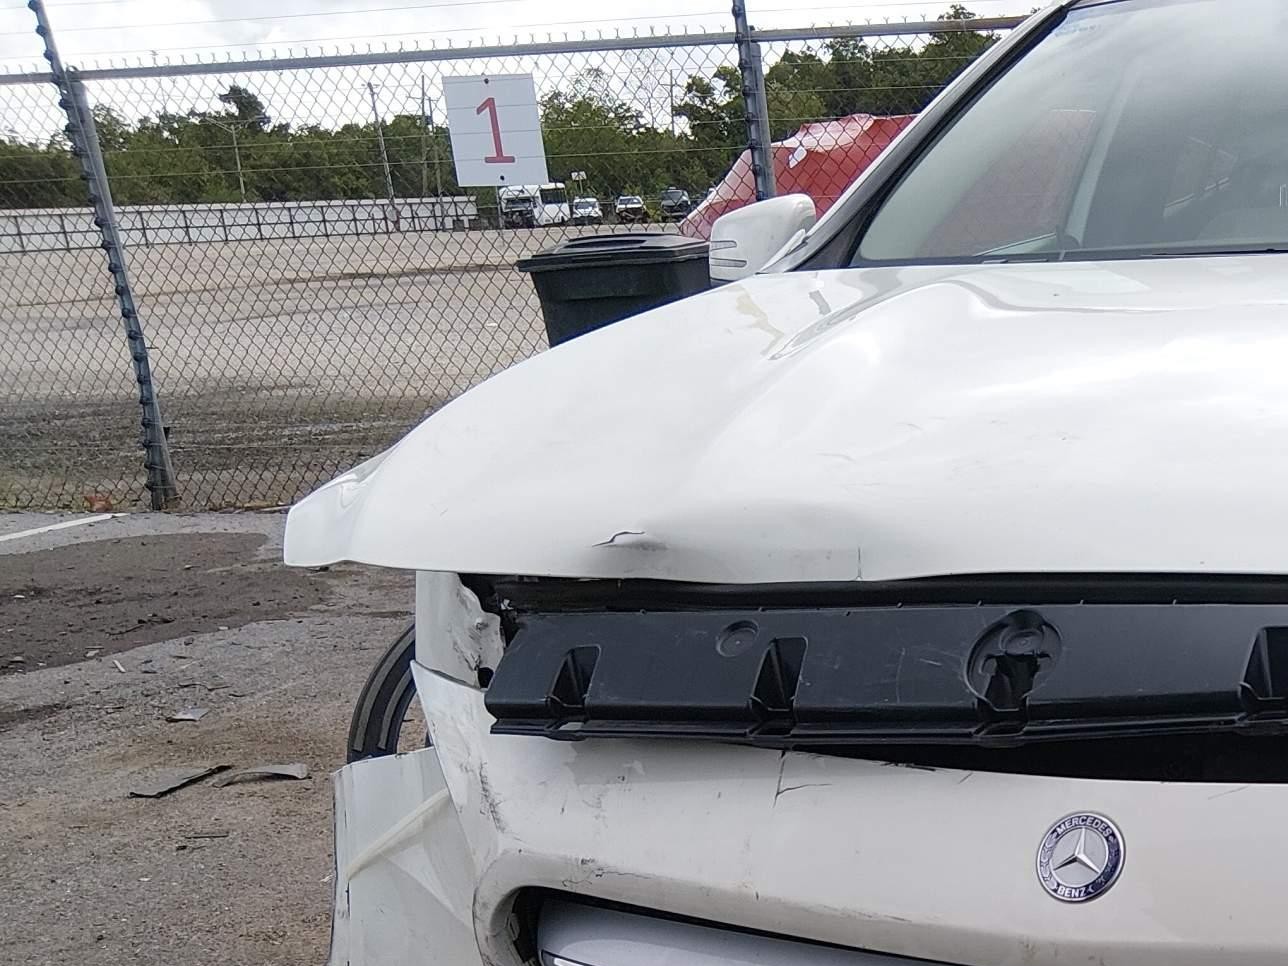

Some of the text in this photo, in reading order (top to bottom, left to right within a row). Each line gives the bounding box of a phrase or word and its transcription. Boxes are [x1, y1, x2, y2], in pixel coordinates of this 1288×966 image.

[476, 97, 516, 163] 1
[1055, 816, 1113, 838] MERCEDES
[1056, 885, 1087, 898] BENZ
